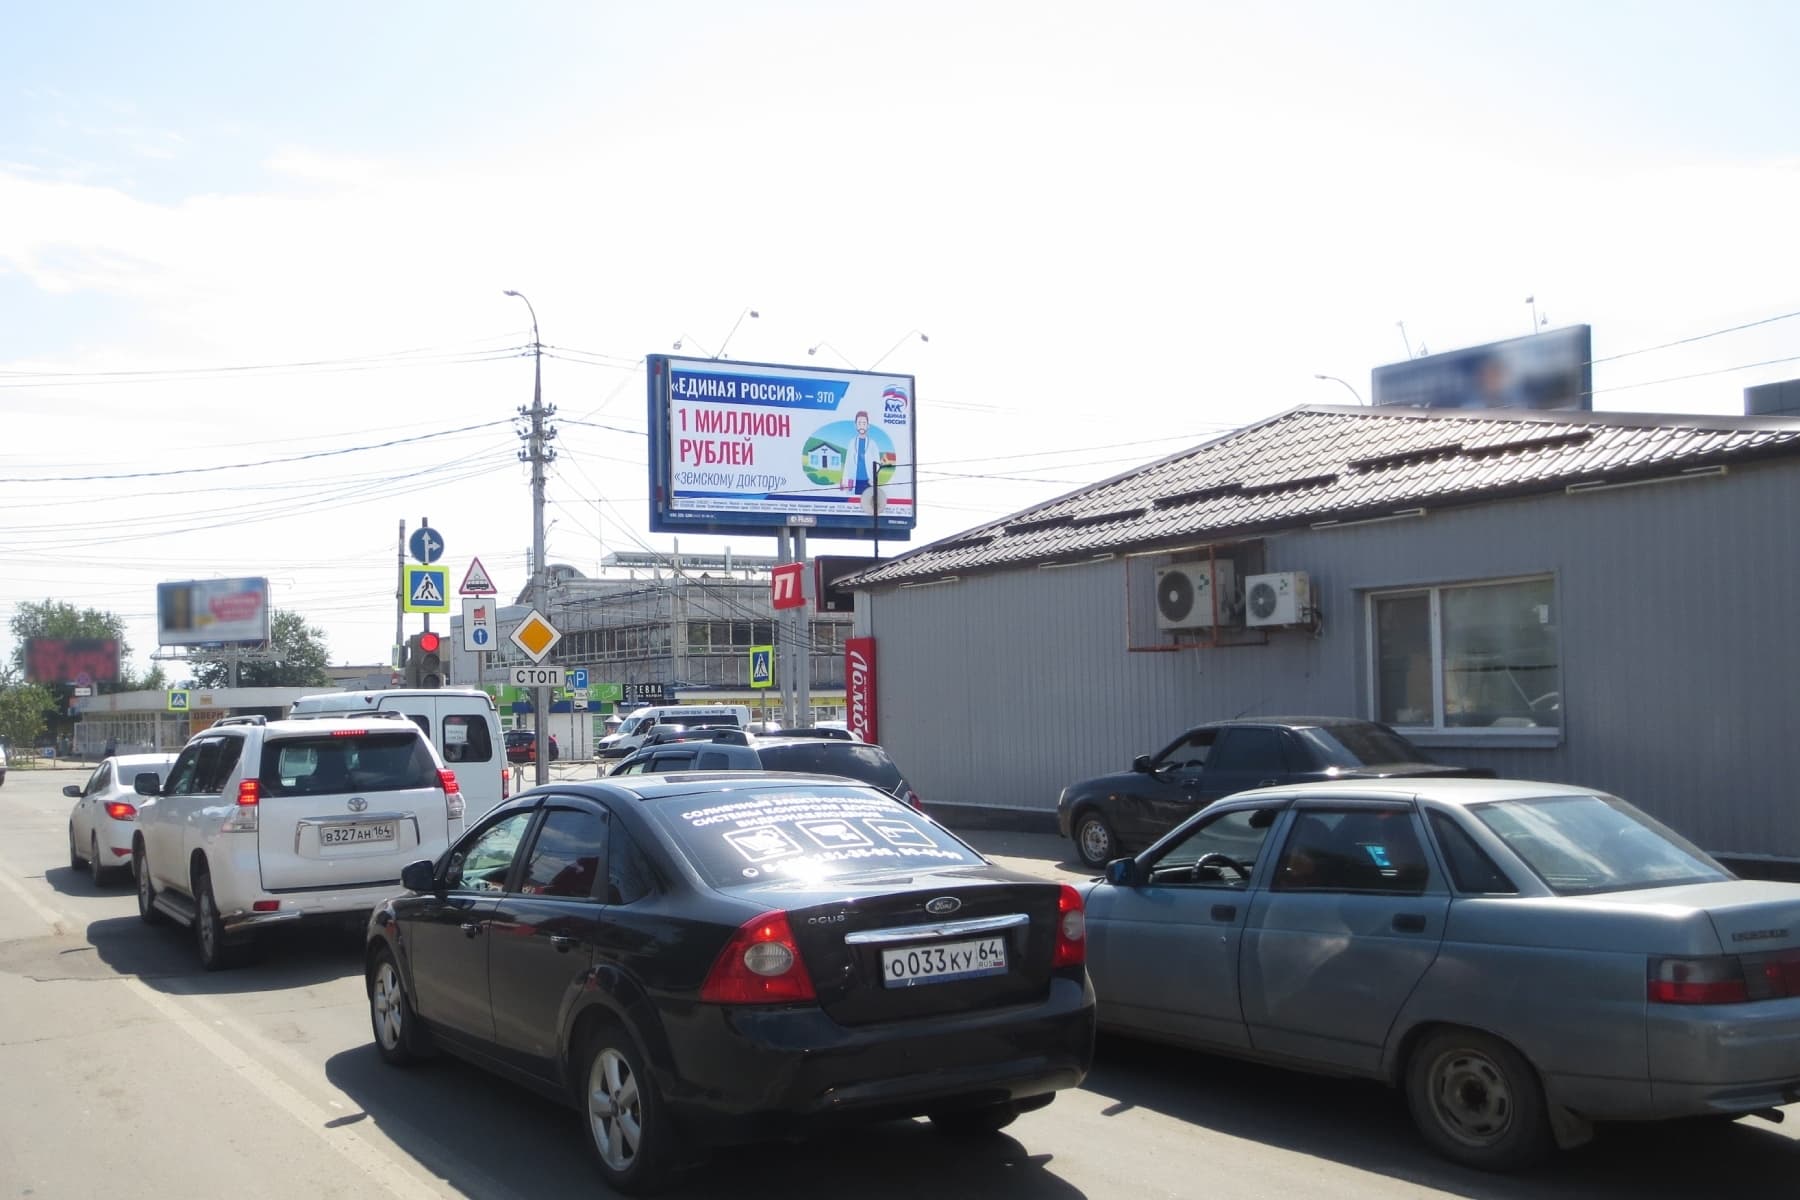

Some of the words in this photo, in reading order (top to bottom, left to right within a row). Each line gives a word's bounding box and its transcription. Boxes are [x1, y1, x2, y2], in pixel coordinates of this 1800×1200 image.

[671, 377, 736, 398] «ЕДИНАЯ
[741, 382, 802, 401] РОССИЯ»
[679, 408, 687, 431] 1
[695, 409, 791, 438] МИЛЛИОН
[680, 437, 754, 467] РУБЛЕЙ
[773, 572, 795, 601] П
[516, 670, 557, 684] СТОП
[373, 825, 390, 836] 164
[978, 941, 999, 960] 64
